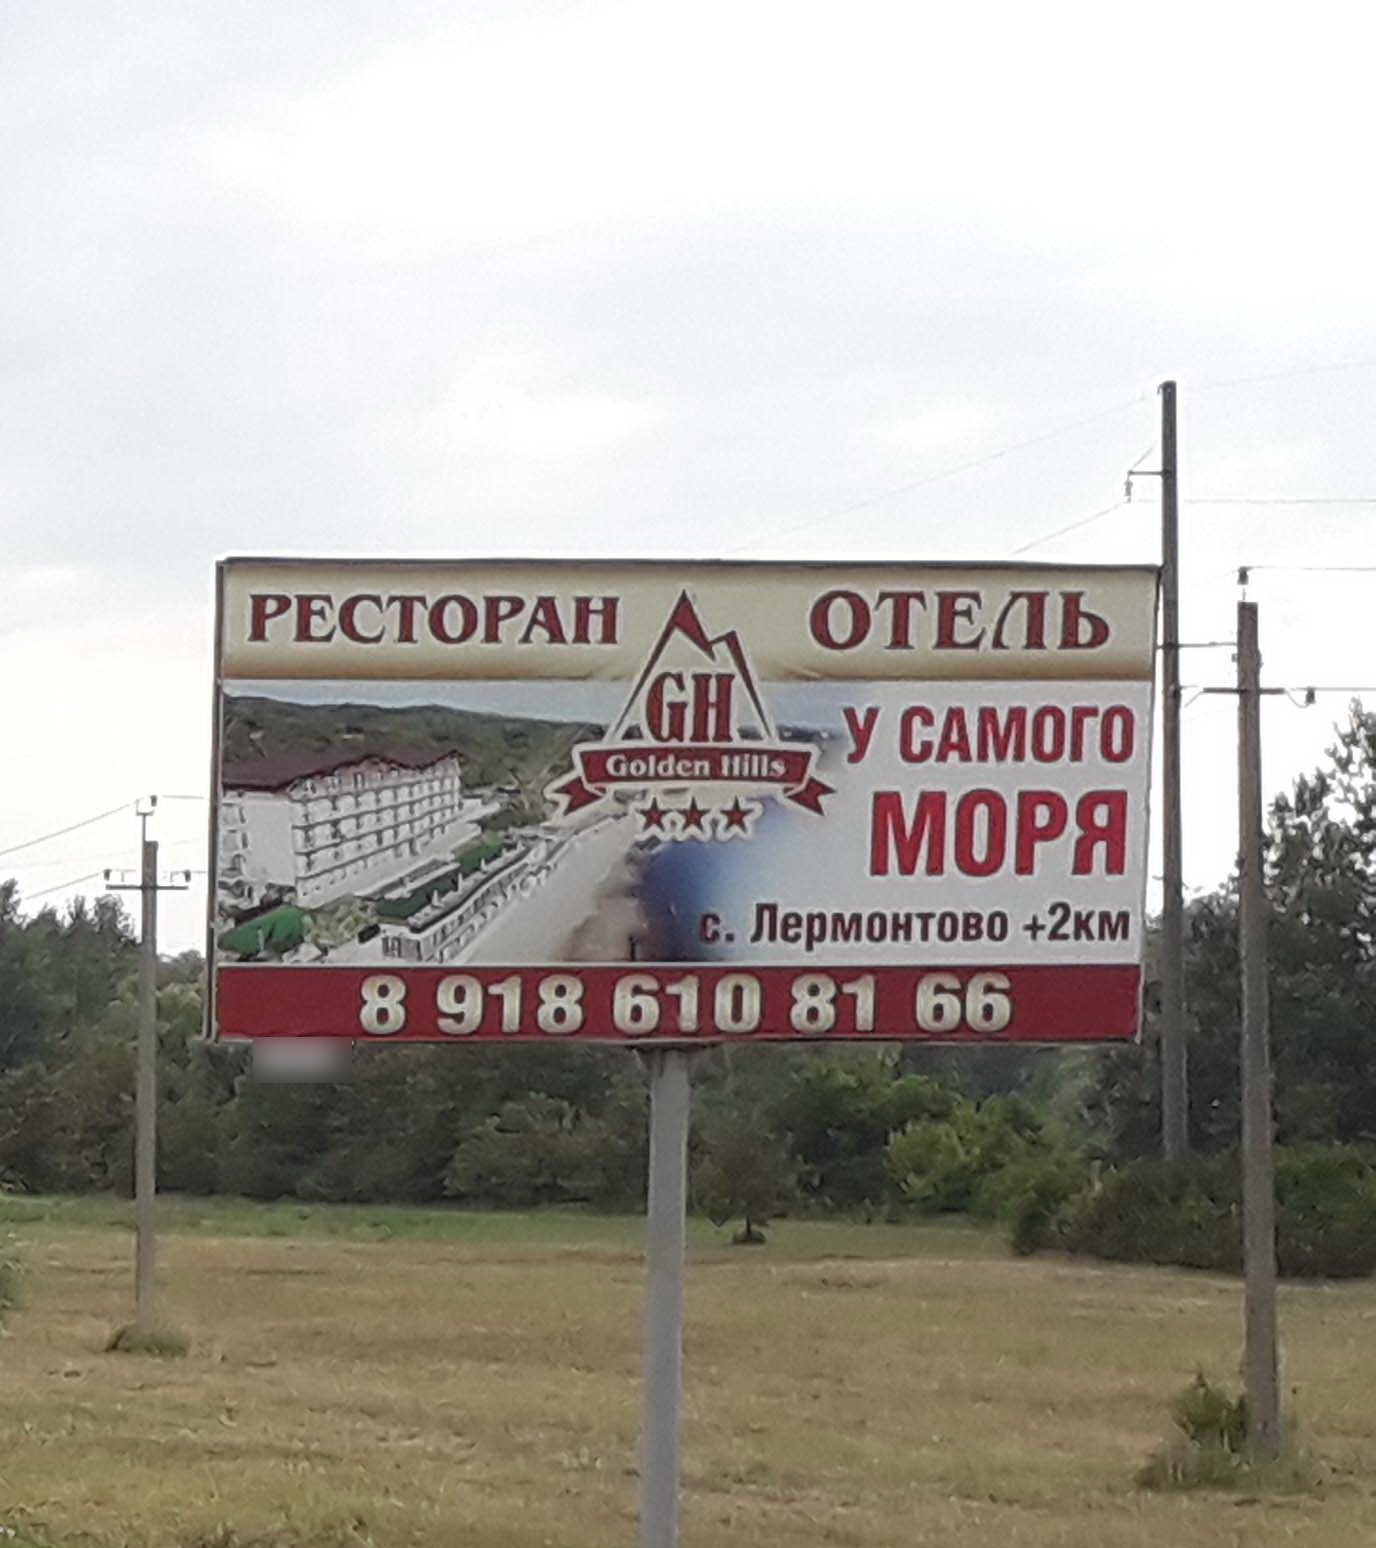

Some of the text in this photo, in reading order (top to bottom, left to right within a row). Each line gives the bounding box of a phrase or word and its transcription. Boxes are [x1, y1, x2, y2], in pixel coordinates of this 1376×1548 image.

[248, 593, 621, 645] РЕСТОРАН
[809, 590, 1110, 650] ОТЕЛЬ
[645, 671, 735, 743] GH
[843, 705, 1135, 764] У САМОГО
[605, 752, 788, 778] Golden Hills
[869, 788, 1128, 878] МОРЯ
[699, 901, 1130, 952] с. Лермонтово +2км
[360, 971, 1012, 1035] 8 918 610 81 66
